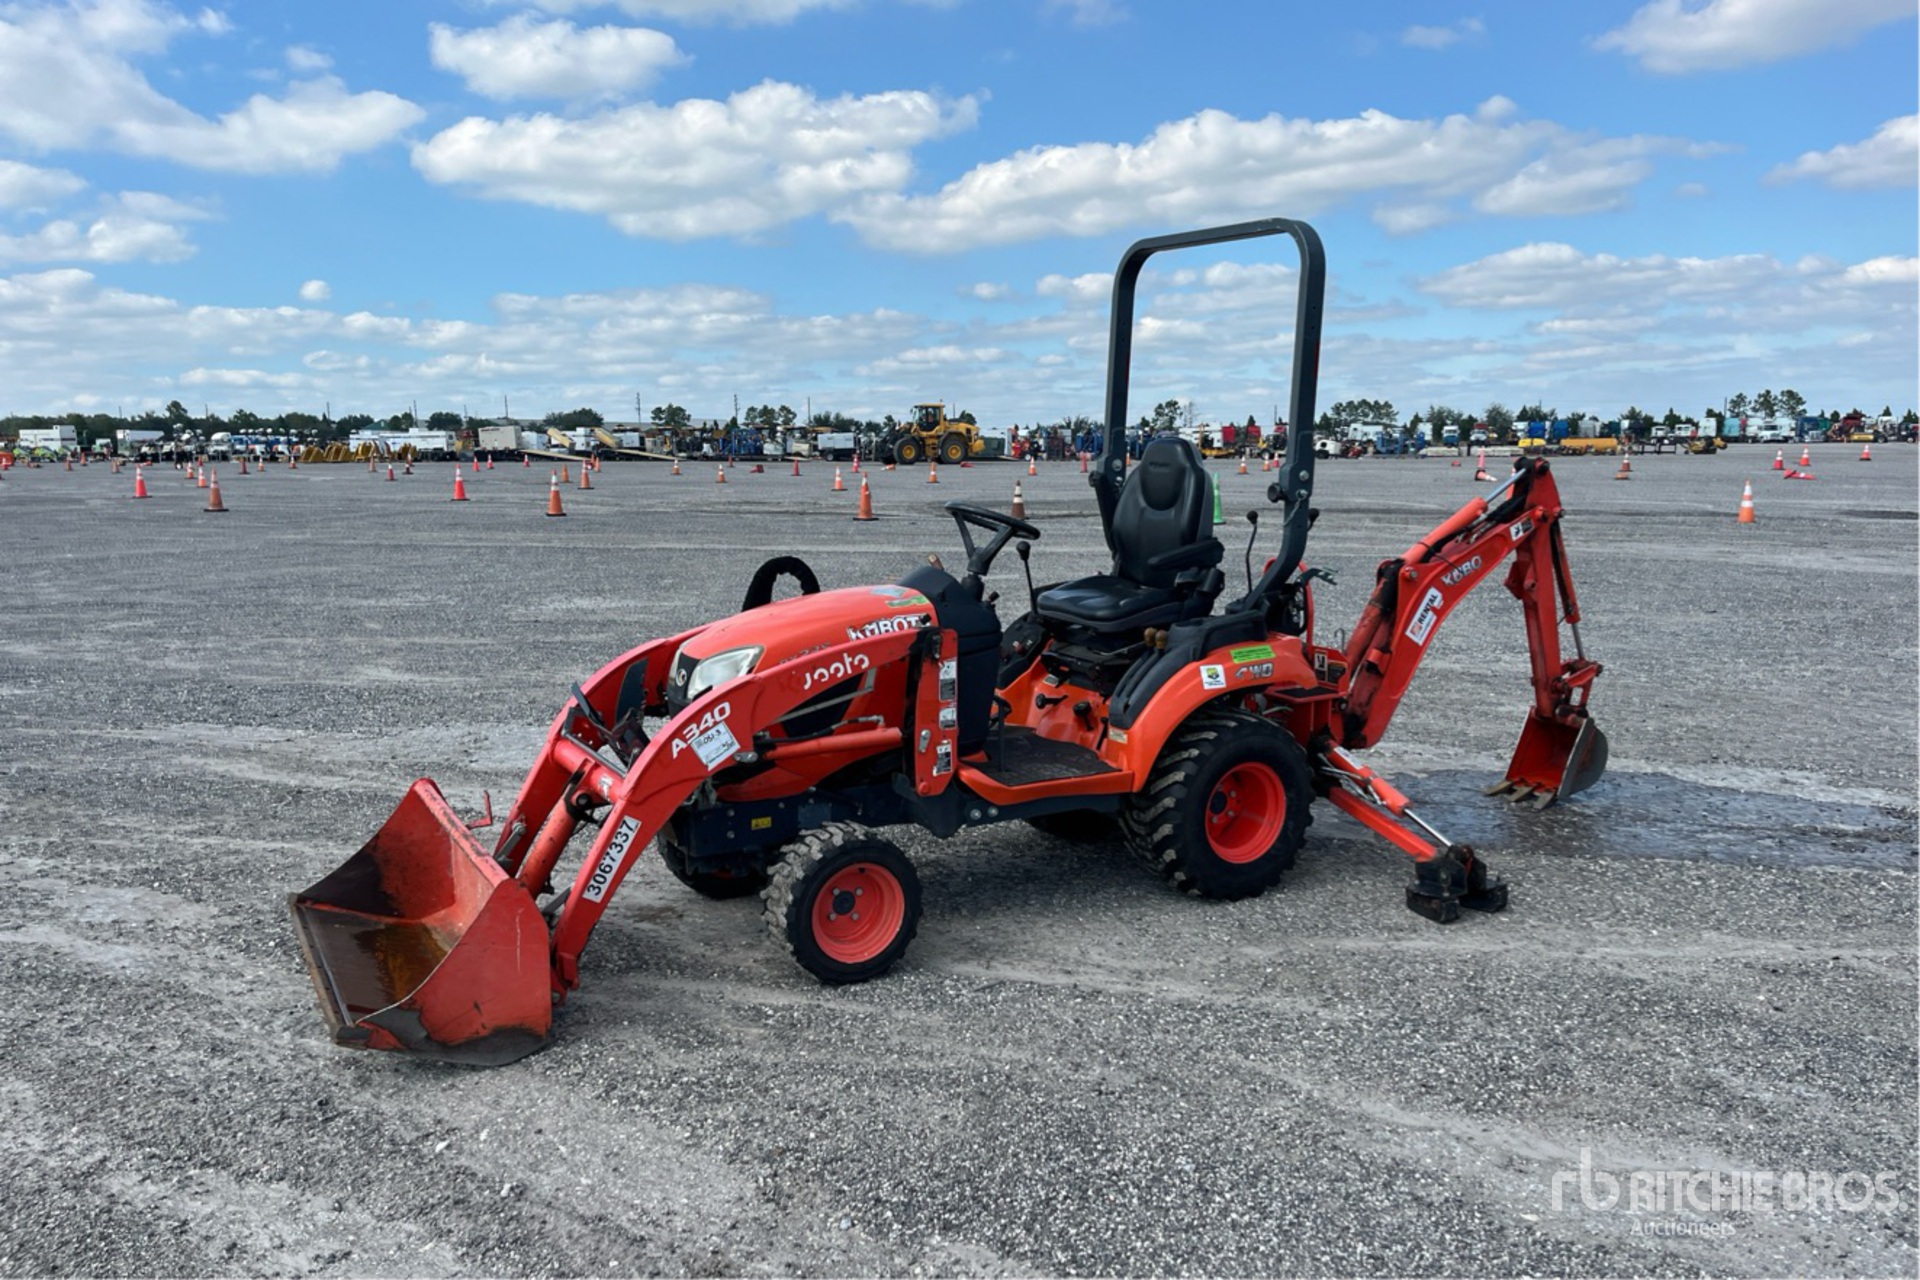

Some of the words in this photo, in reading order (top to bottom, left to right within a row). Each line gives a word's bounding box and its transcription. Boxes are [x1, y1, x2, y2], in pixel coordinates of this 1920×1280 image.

[847, 613, 931, 641] KUBOT
[671, 701, 731, 760] A340
[587, 819, 634, 896] 3067337
